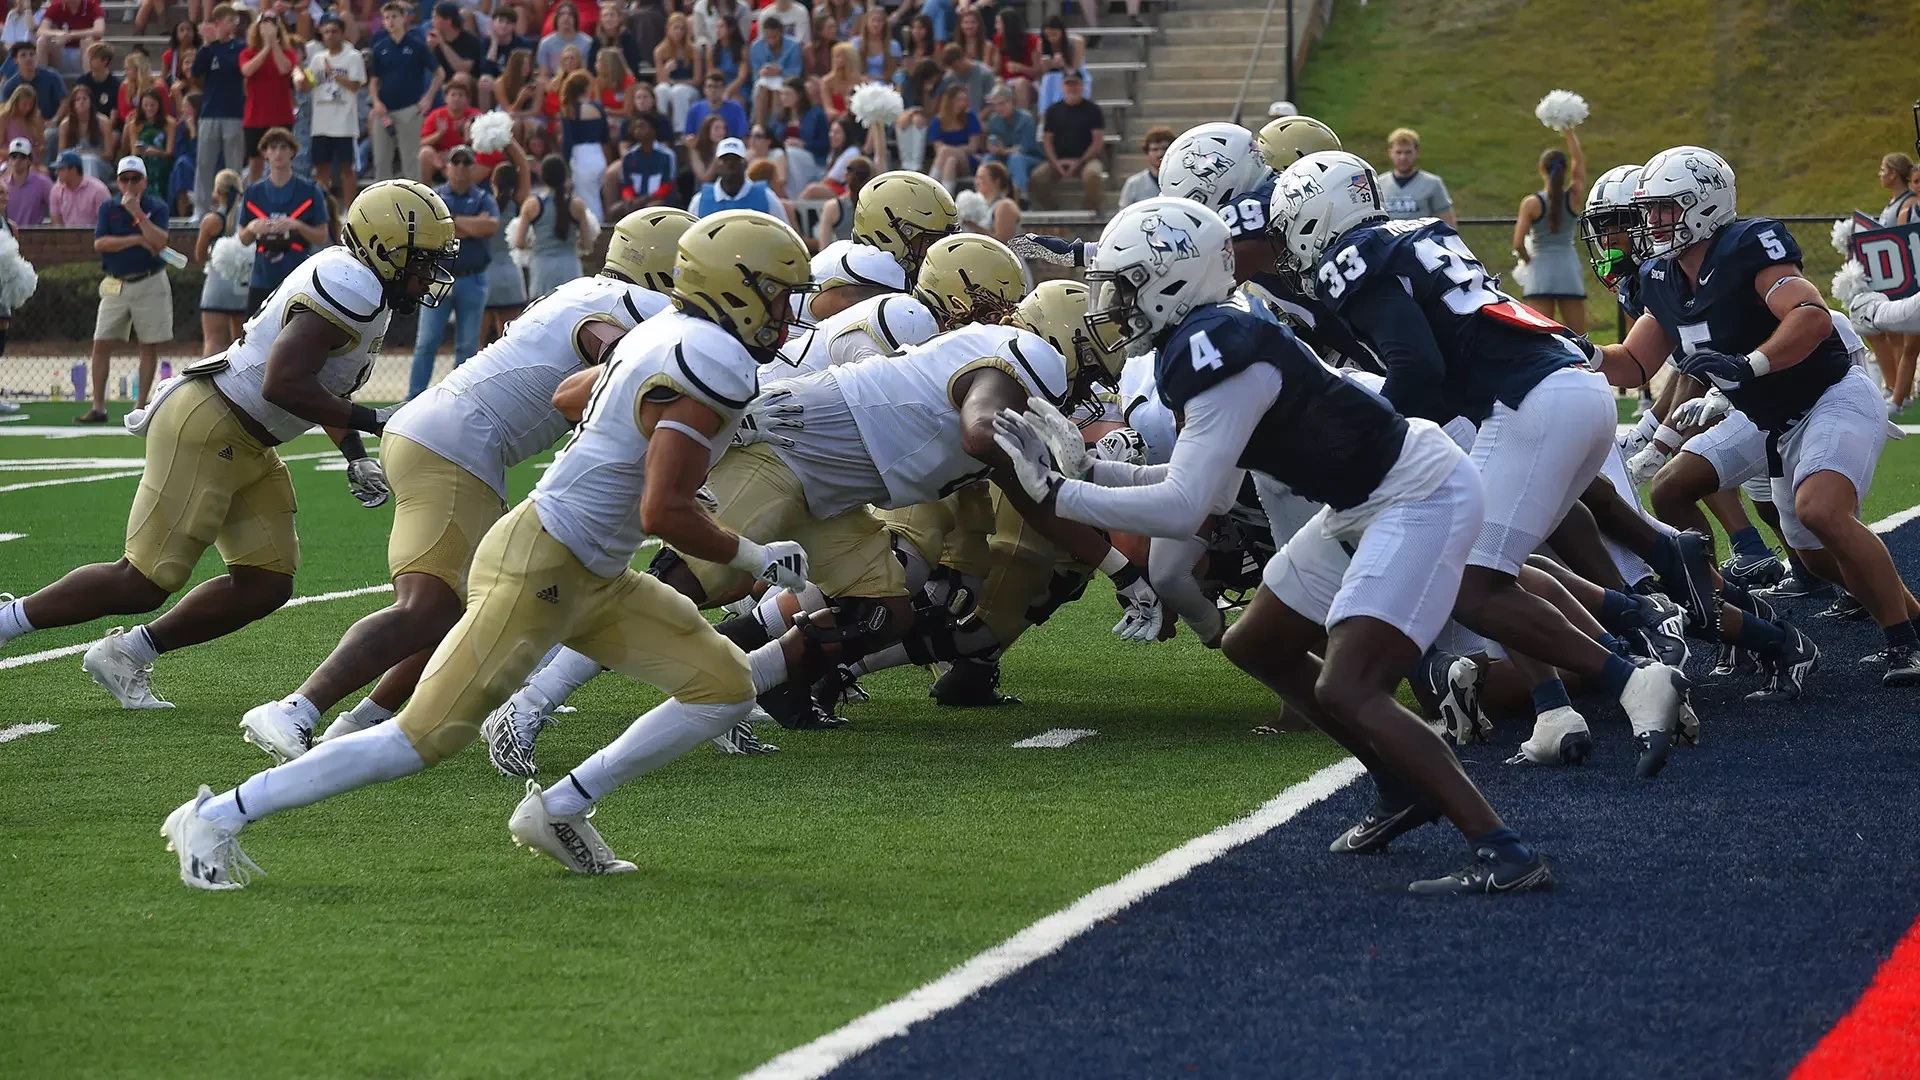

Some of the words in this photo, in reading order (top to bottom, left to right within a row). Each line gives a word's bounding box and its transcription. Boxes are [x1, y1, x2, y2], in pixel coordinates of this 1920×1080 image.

[1217, 198, 1265, 237] 29
[1360, 192, 1371, 203] 33
[1757, 229, 1788, 261] 5
[1318, 244, 1368, 300] 33
[1861, 239, 1906, 292] D
[1189, 330, 1224, 372] 4
